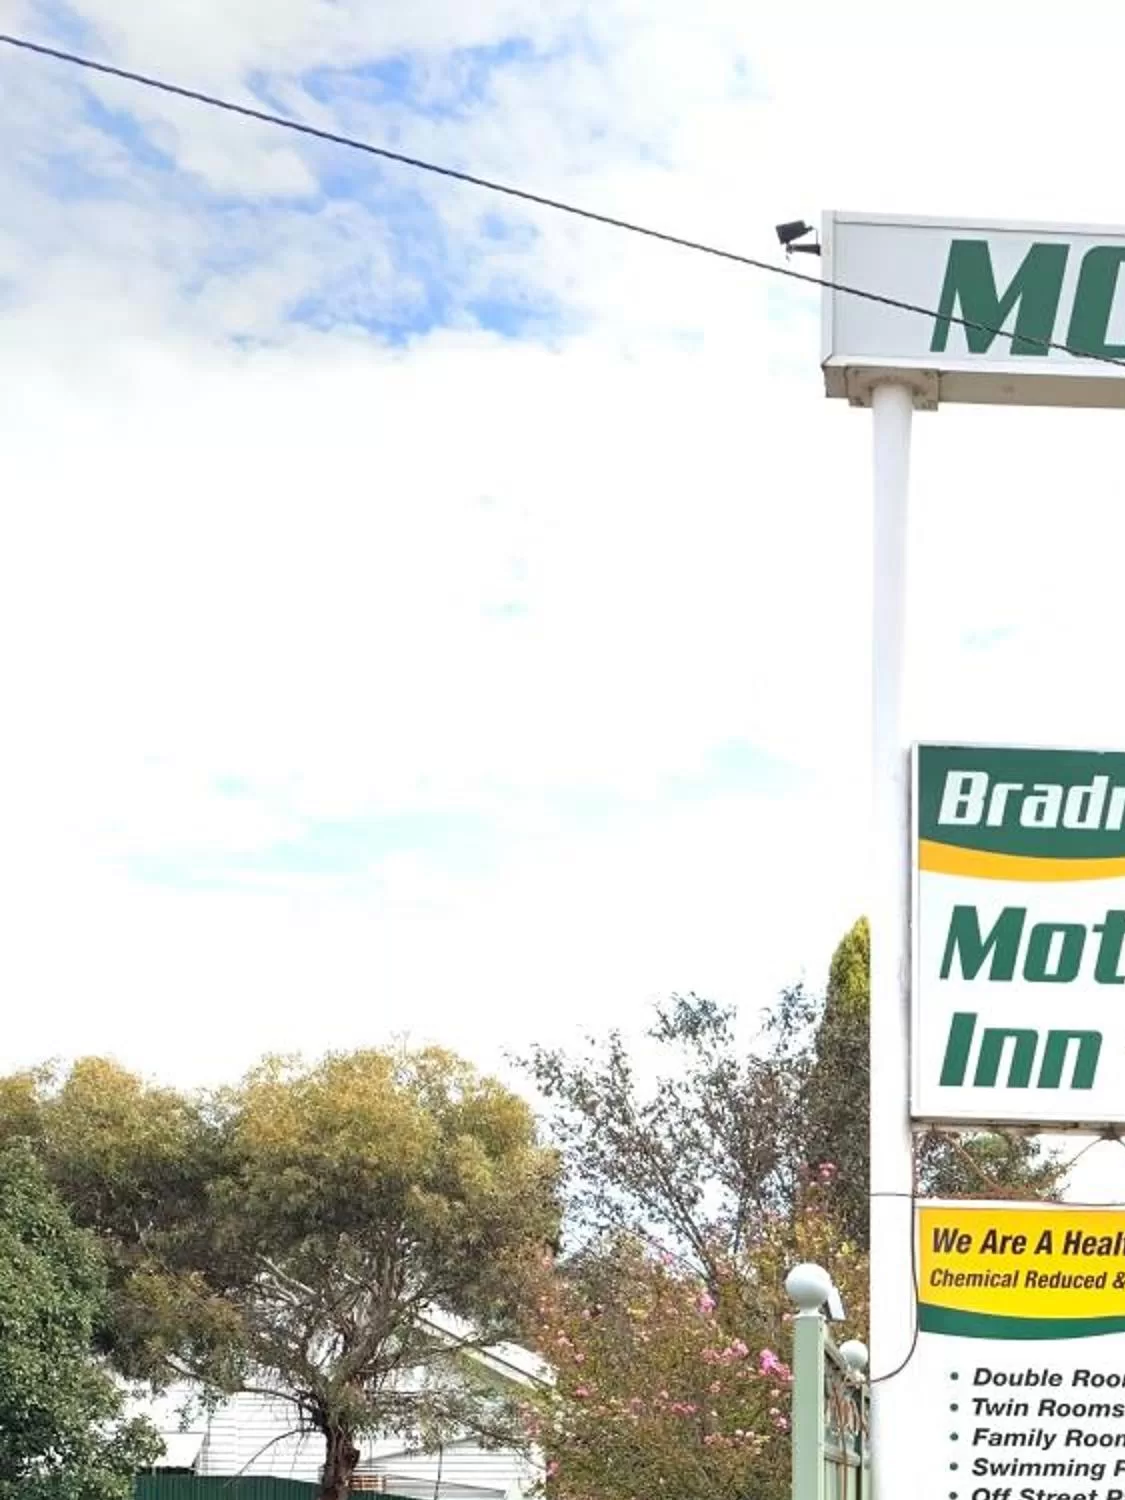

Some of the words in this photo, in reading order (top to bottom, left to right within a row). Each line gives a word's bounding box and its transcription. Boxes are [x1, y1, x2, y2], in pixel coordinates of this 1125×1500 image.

[939, 1012, 1103, 1089] Inn
[932, 1228, 972, 1253] We
[979, 1230, 1026, 1254] Are
[1035, 1230, 1054, 1255] A
[930, 1269, 1018, 1288] Chemical
[1024, 1271, 1107, 1289] Reduced
[973, 1368, 1063, 1387] Double
[972, 1399, 1029, 1417] Twin
[1038, 1400, 1125, 1418] Rooms
[972, 1429, 1056, 1450] Family
[972, 1458, 1106, 1480] Swimming
